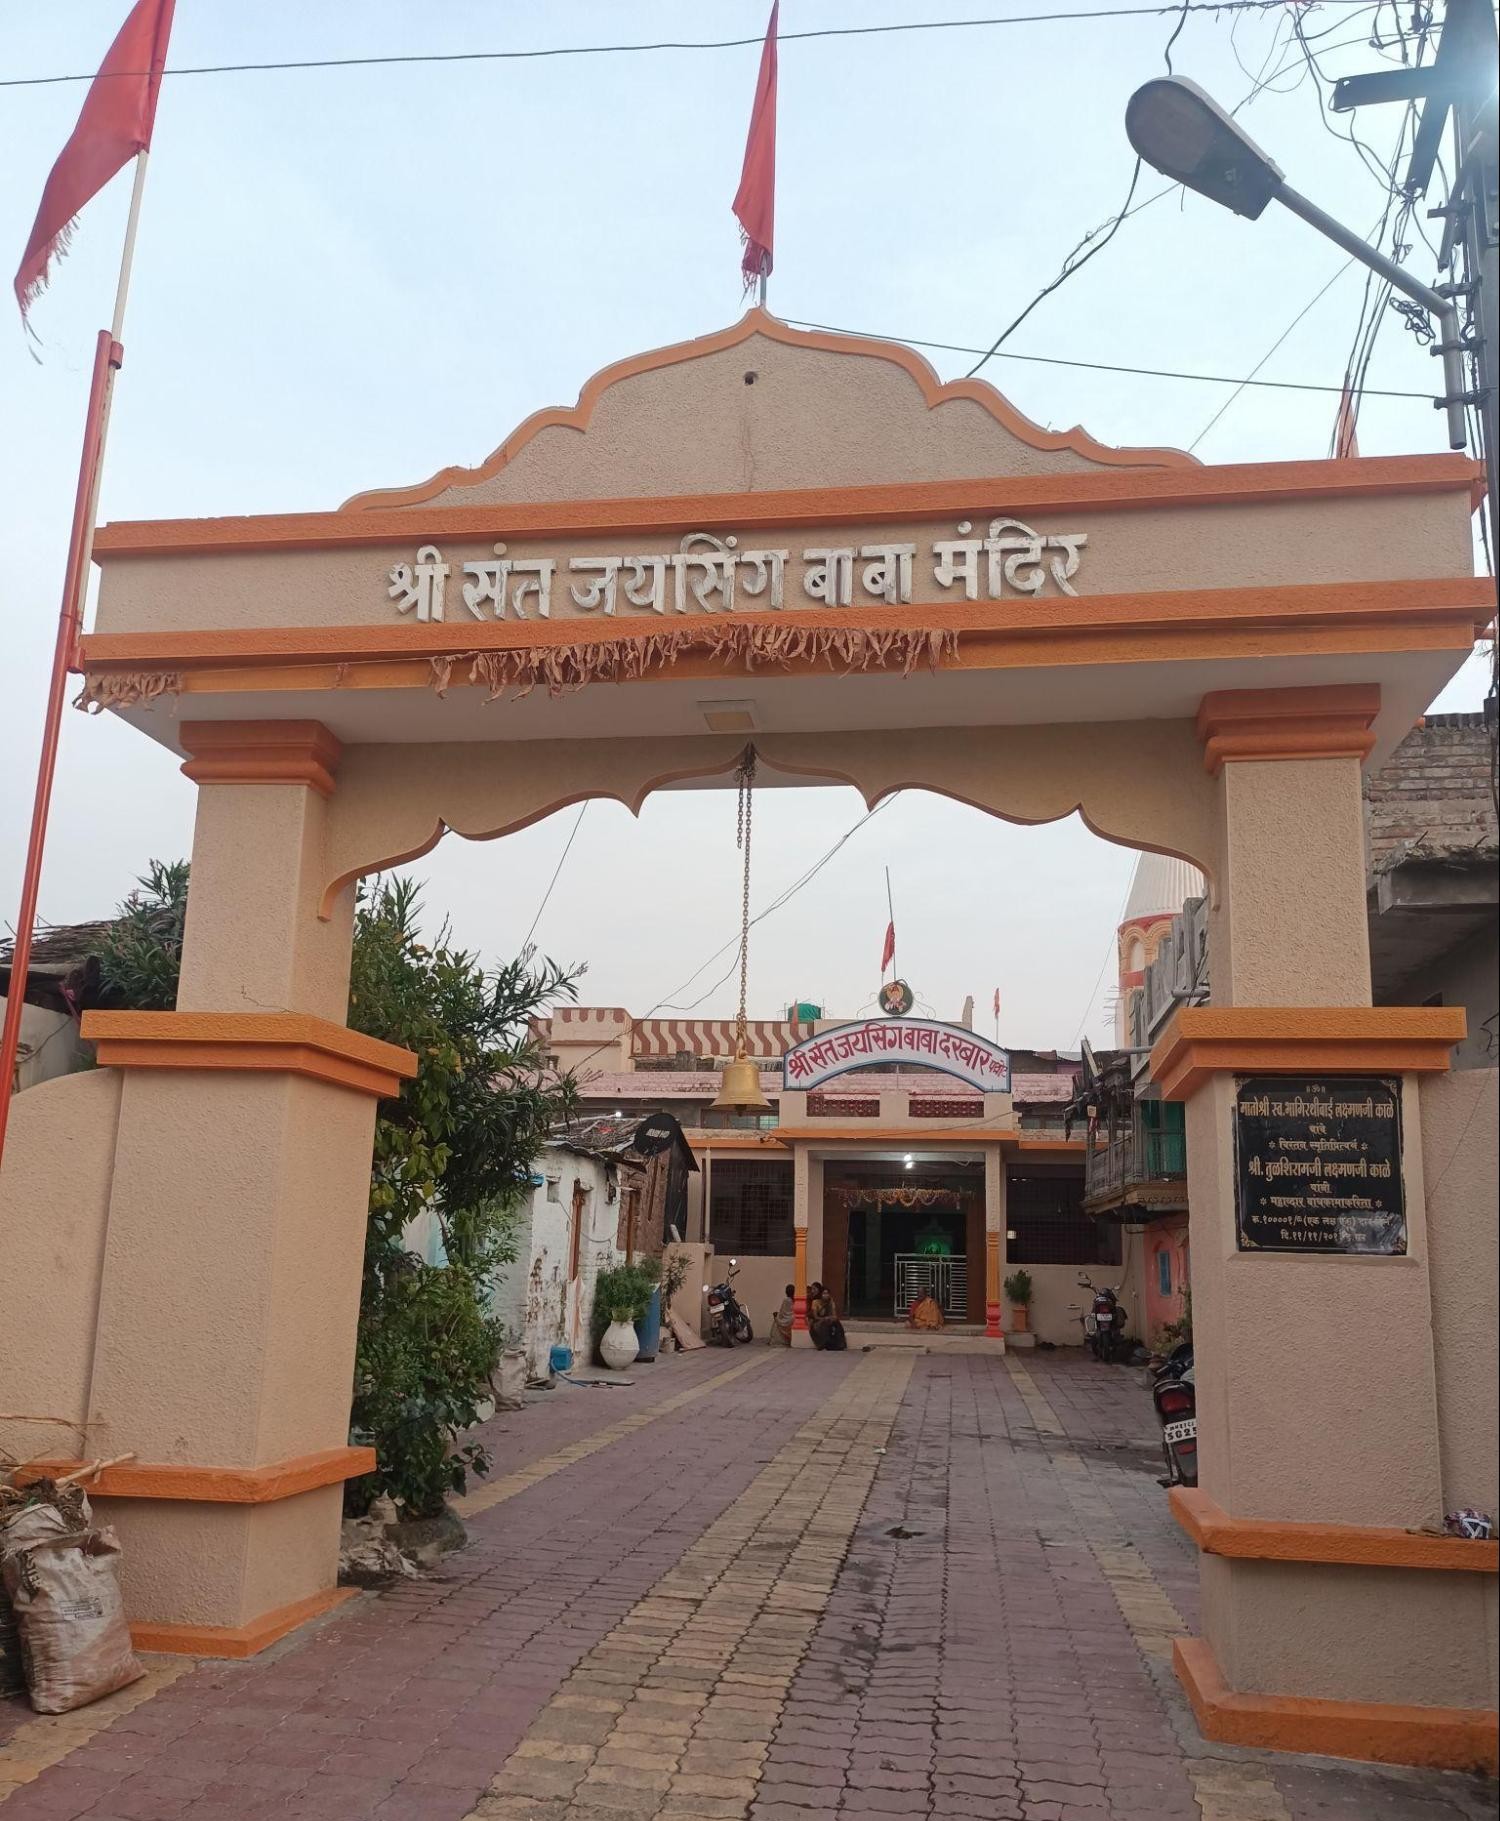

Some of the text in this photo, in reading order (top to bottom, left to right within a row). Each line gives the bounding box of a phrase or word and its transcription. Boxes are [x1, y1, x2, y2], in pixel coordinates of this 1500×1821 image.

[388, 516, 1088, 623] श्री संत जयसिंग बाबा मंदिर
[788, 1050, 814, 1079] श्री
[808, 1040, 840, 1071] संत
[835, 1023, 904, 1057] जयसिंग
[903, 1027, 939, 1054] बाबा
[939, 1033, 991, 1075] दरबार
[1239, 1096, 1270, 1118] मातोश्री
[1335, 1097, 1373, 1118] लक्ष्मणजी
[1375, 1098, 1394, 1118] काळे
[1248, 1156, 1391, 1181] श्री. तुळशिरामजी लक्ष्मणजी काळे
